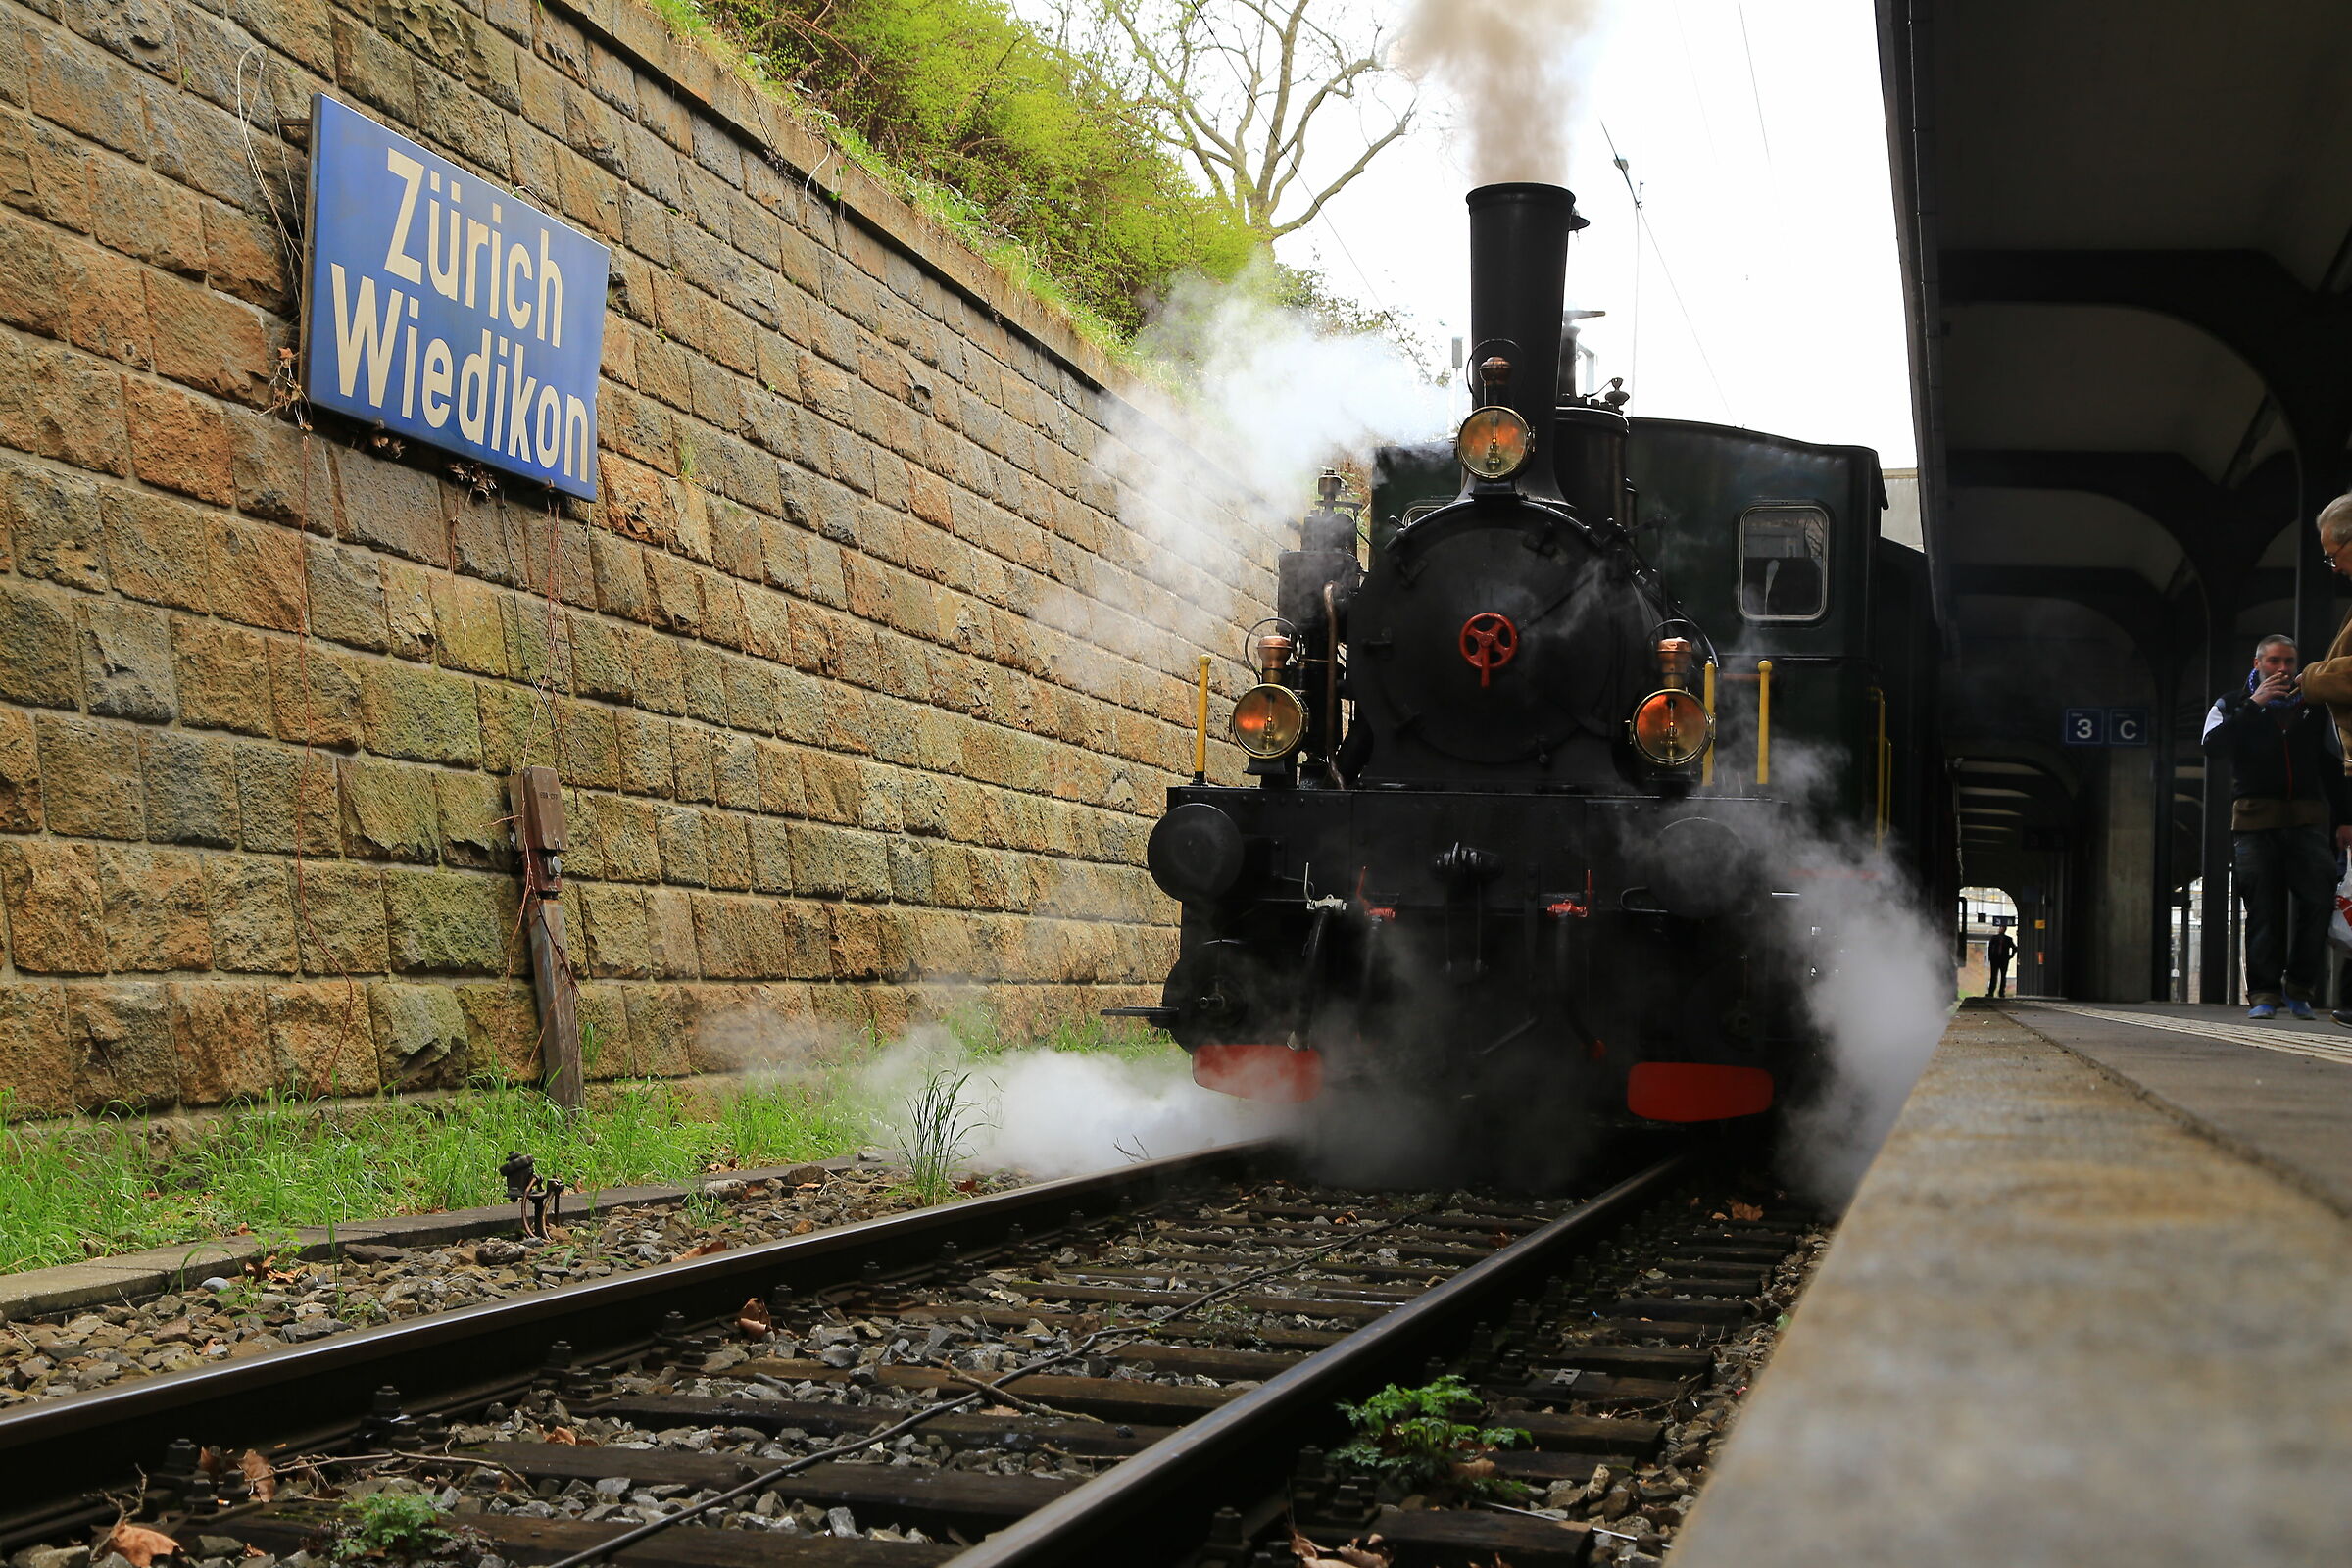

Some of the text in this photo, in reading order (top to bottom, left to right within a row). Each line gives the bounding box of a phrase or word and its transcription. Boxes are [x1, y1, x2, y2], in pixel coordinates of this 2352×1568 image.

[384, 147, 564, 348] Zürich
[329, 262, 588, 483] Wiedikon
[2077, 719, 2136, 739] 3 C
